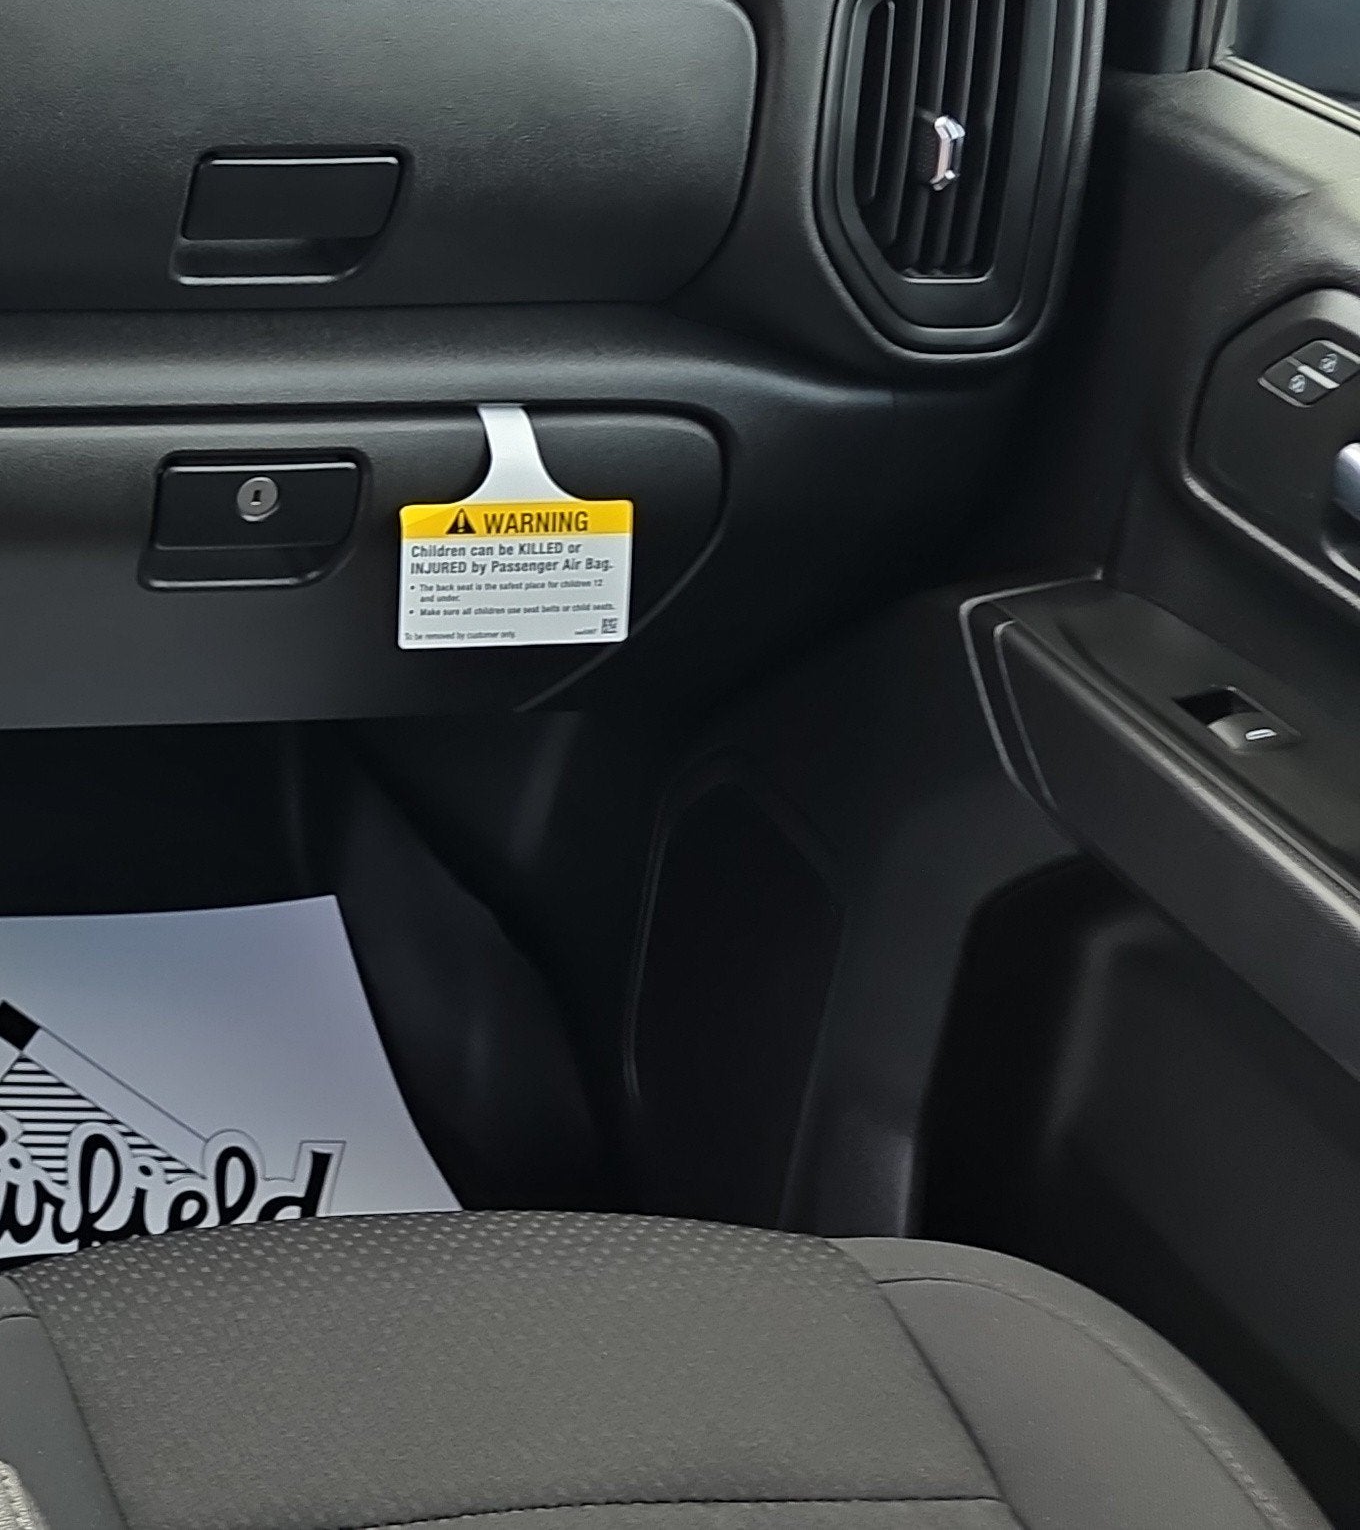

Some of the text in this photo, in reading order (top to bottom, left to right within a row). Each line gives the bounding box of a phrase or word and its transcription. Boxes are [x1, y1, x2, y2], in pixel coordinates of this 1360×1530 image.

[484, 511, 588, 534] WARNING
[412, 543, 582, 557] Children can be KILLED or
[411, 558, 614, 576] INJURED by Passenger Air Bag.
[436, 583, 454, 591] back
[485, 582, 497, 590] the
[525, 581, 546, 590] place
[560, 580, 591, 588] children
[594, 579, 603, 587] 12
[474, 607, 505, 615] children
[572, 604, 590, 612] child
[593, 603, 615, 611] seats.
